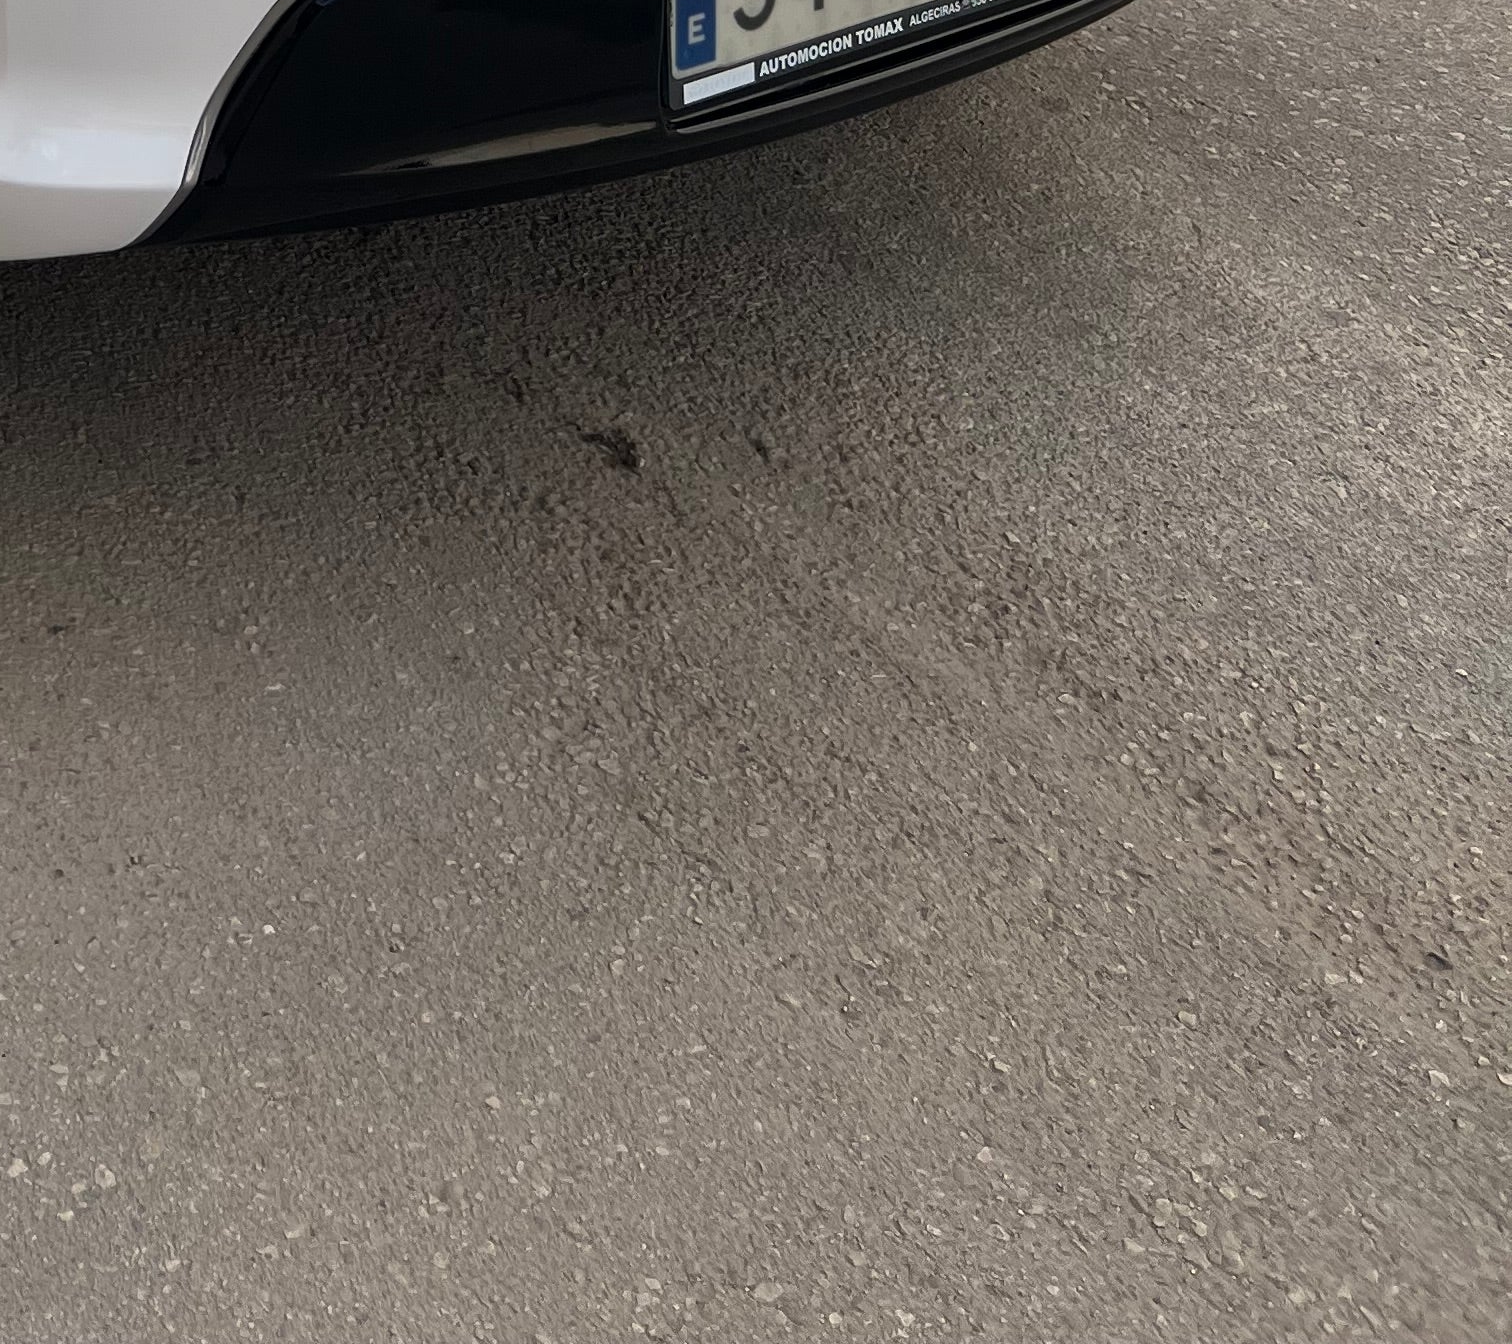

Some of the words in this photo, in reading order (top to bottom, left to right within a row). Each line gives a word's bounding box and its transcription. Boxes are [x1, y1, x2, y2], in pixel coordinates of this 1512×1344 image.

[688, 12, 706, 45] E
[759, 33, 853, 77] AUTOMOCION
[855, 17, 904, 45] TOMAX
[909, 0, 961, 27] ALGECIRAS
